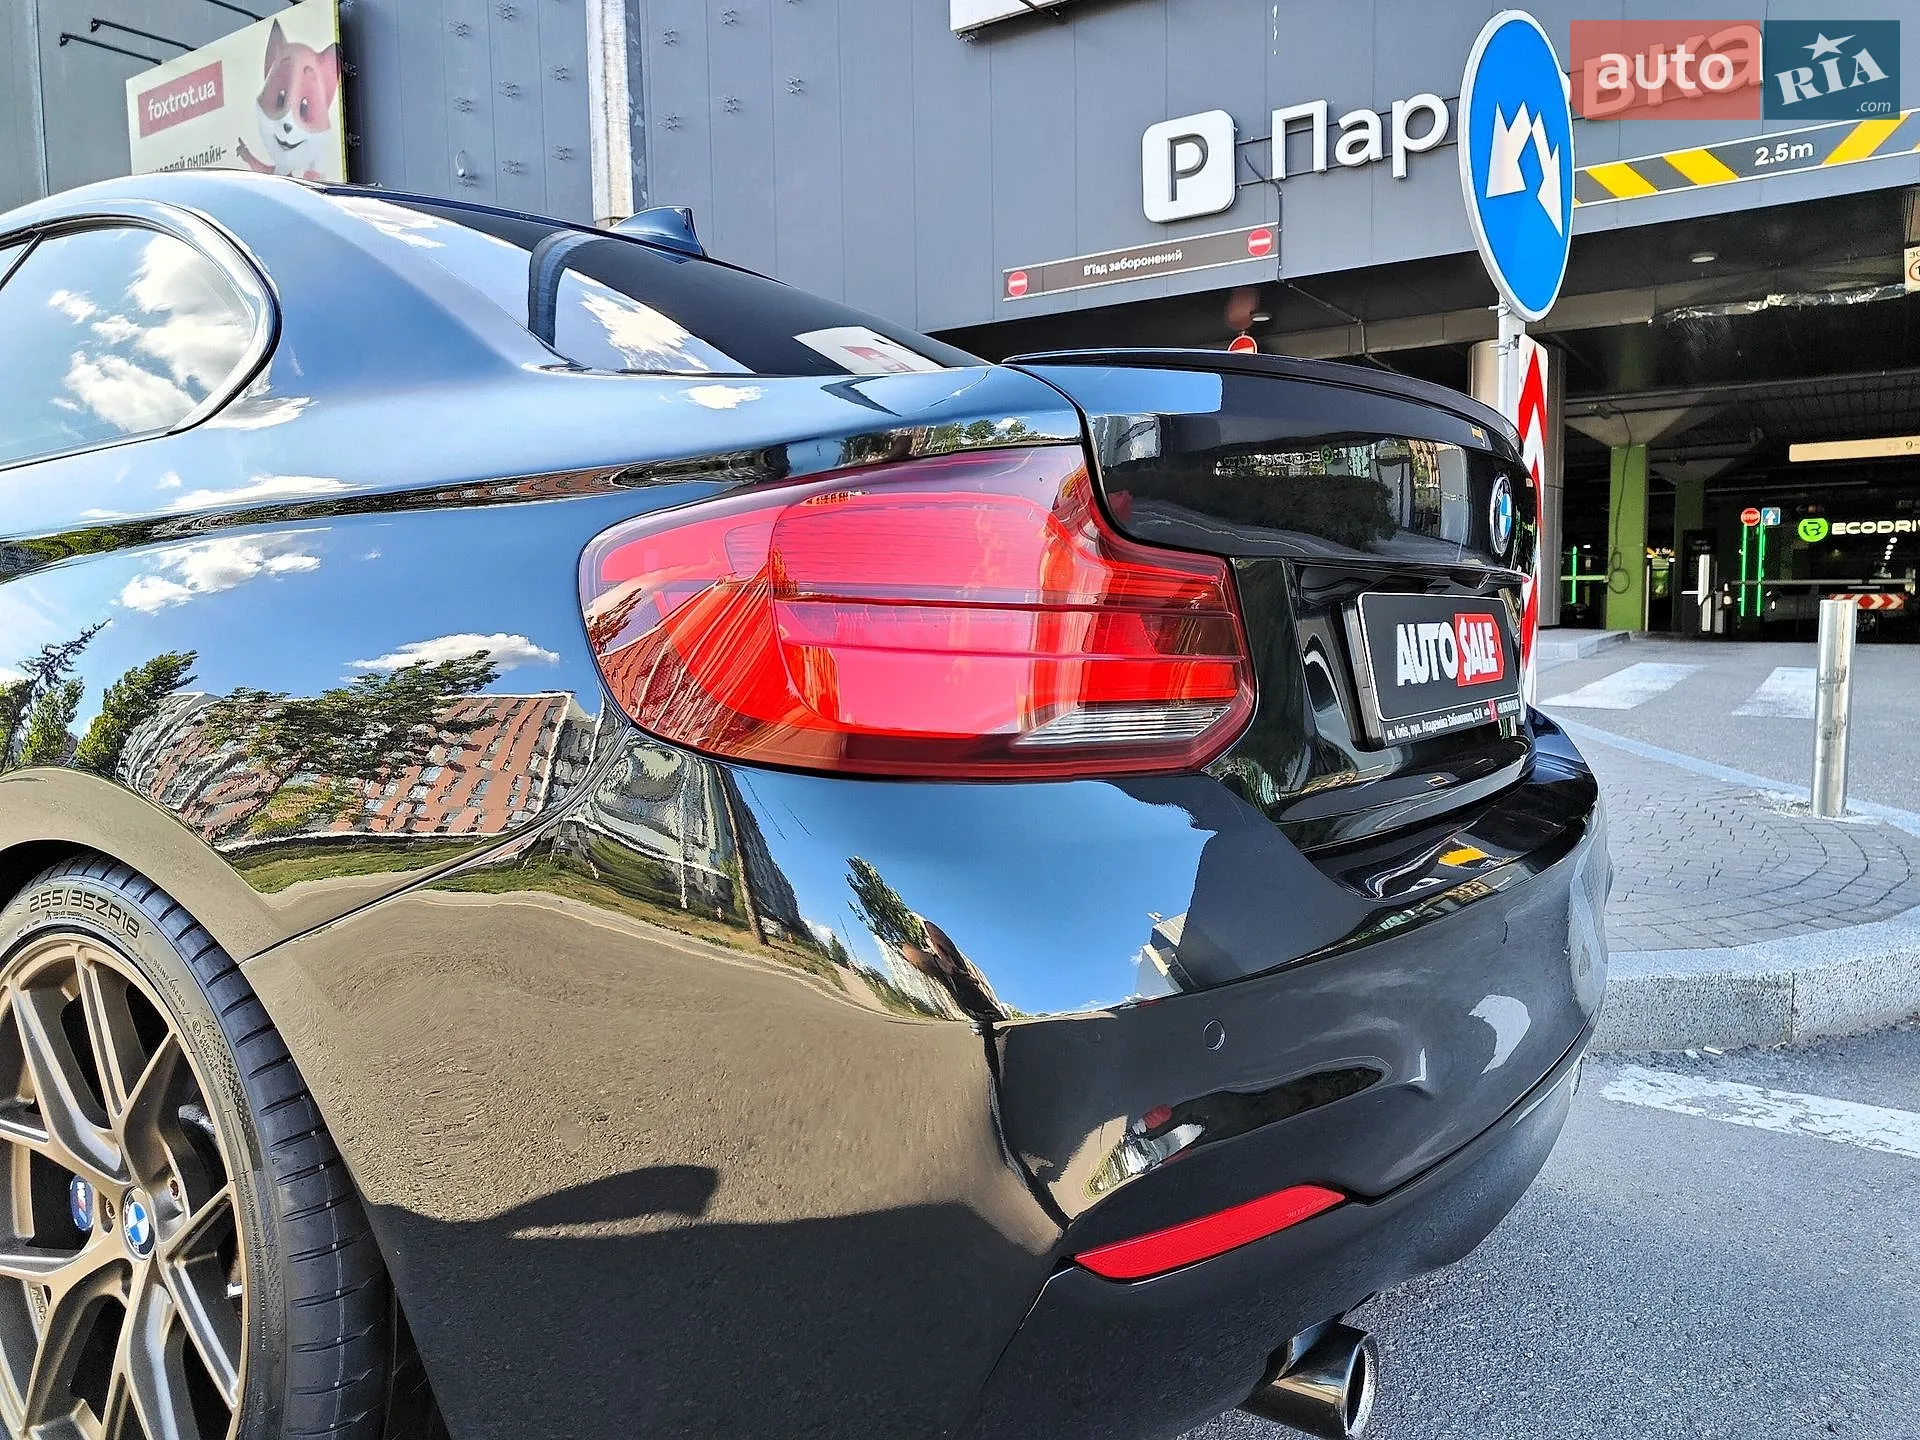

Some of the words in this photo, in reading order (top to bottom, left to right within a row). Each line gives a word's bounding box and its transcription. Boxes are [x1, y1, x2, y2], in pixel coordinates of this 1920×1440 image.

[148, 81, 216, 121] foxtrot.ua
[1109, 249, 1183, 272] заборонений
[1397, 621, 1459, 687] AUTO
[29, 888, 140, 940] 255/35ZR18
